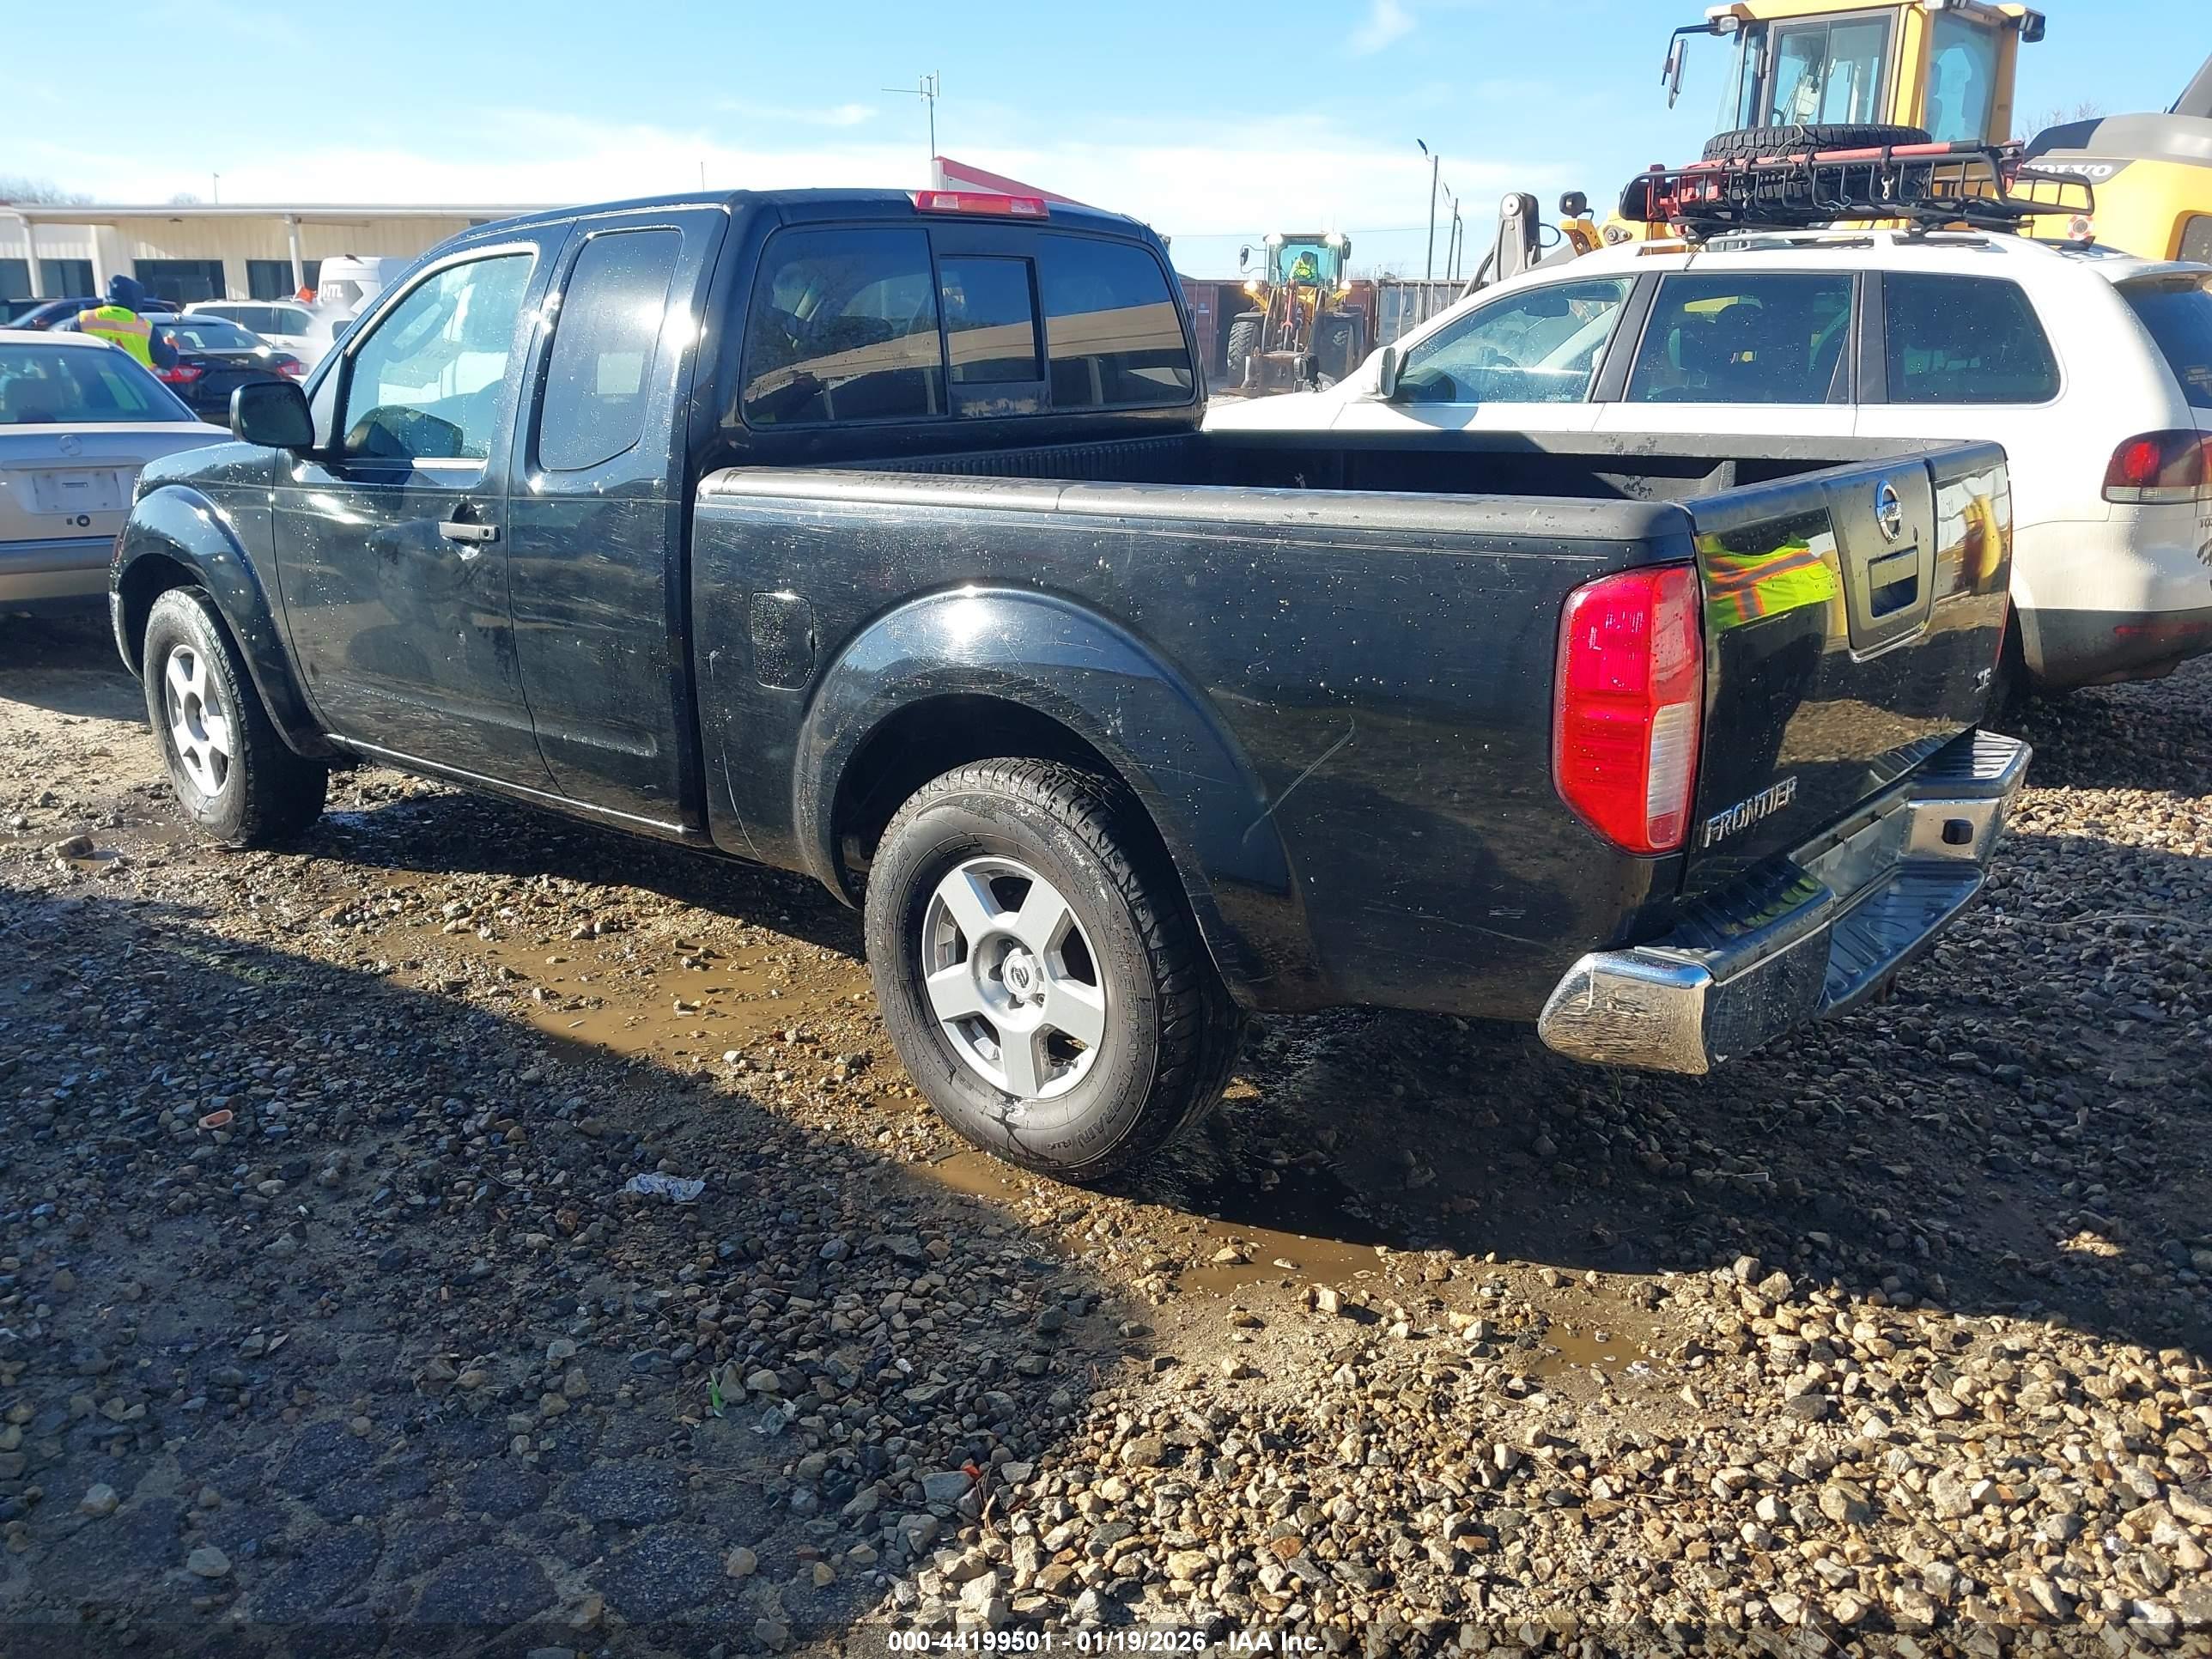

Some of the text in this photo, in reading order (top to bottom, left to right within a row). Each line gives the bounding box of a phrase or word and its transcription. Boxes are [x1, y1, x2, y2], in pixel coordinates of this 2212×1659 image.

[1974, 666, 1992, 694] SE
[1703, 775, 1798, 848] FRONTIER
[1115, 944, 1140, 1071] HIGHWAY
[1078, 1071, 1133, 1148] TERRAIN
